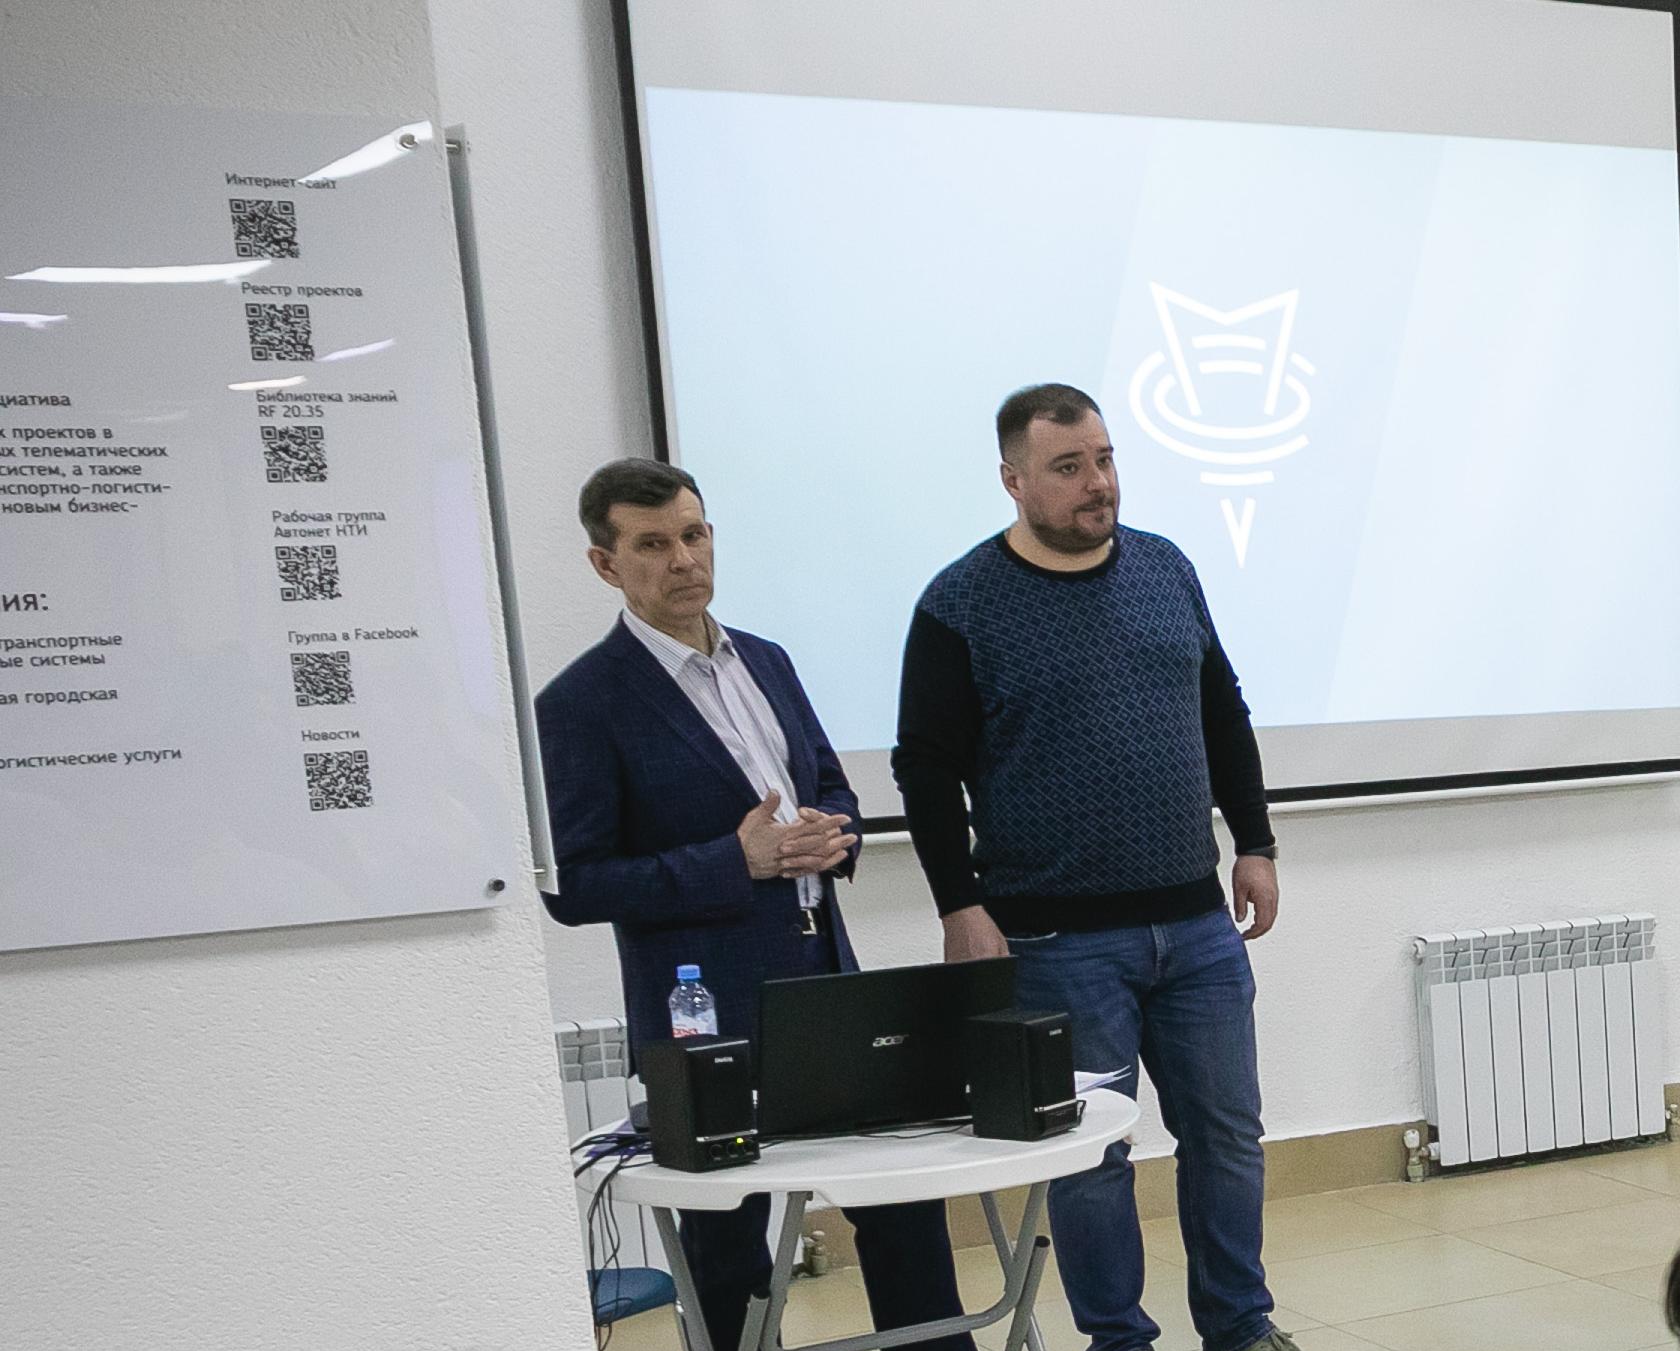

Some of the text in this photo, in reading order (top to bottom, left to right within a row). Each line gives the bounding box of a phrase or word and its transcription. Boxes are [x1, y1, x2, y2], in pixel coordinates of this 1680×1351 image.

[241, 282, 363, 298] Реестр проектов
[256, 390, 398, 402] Библиотека знаний
[258, 405, 325, 418] RF 20.35
[12, 428, 96, 441] проектов
[103, 428, 113, 439] в
[21, 446, 169, 457] телематических
[72, 465, 83, 476] а
[89, 465, 142, 476] также
[2, 498, 138, 514] новым бизнес-
[272, 510, 387, 524] Рабочая группа
[274, 524, 368, 538] Автонет НТИ
[288, 627, 419, 645] Группа в Facebook
[30, 654, 105, 667] системы
[25, 689, 118, 705] городская
[301, 730, 360, 742] Новости
[123, 749, 182, 765] услуги
[872, 1034, 909, 1047] acer
